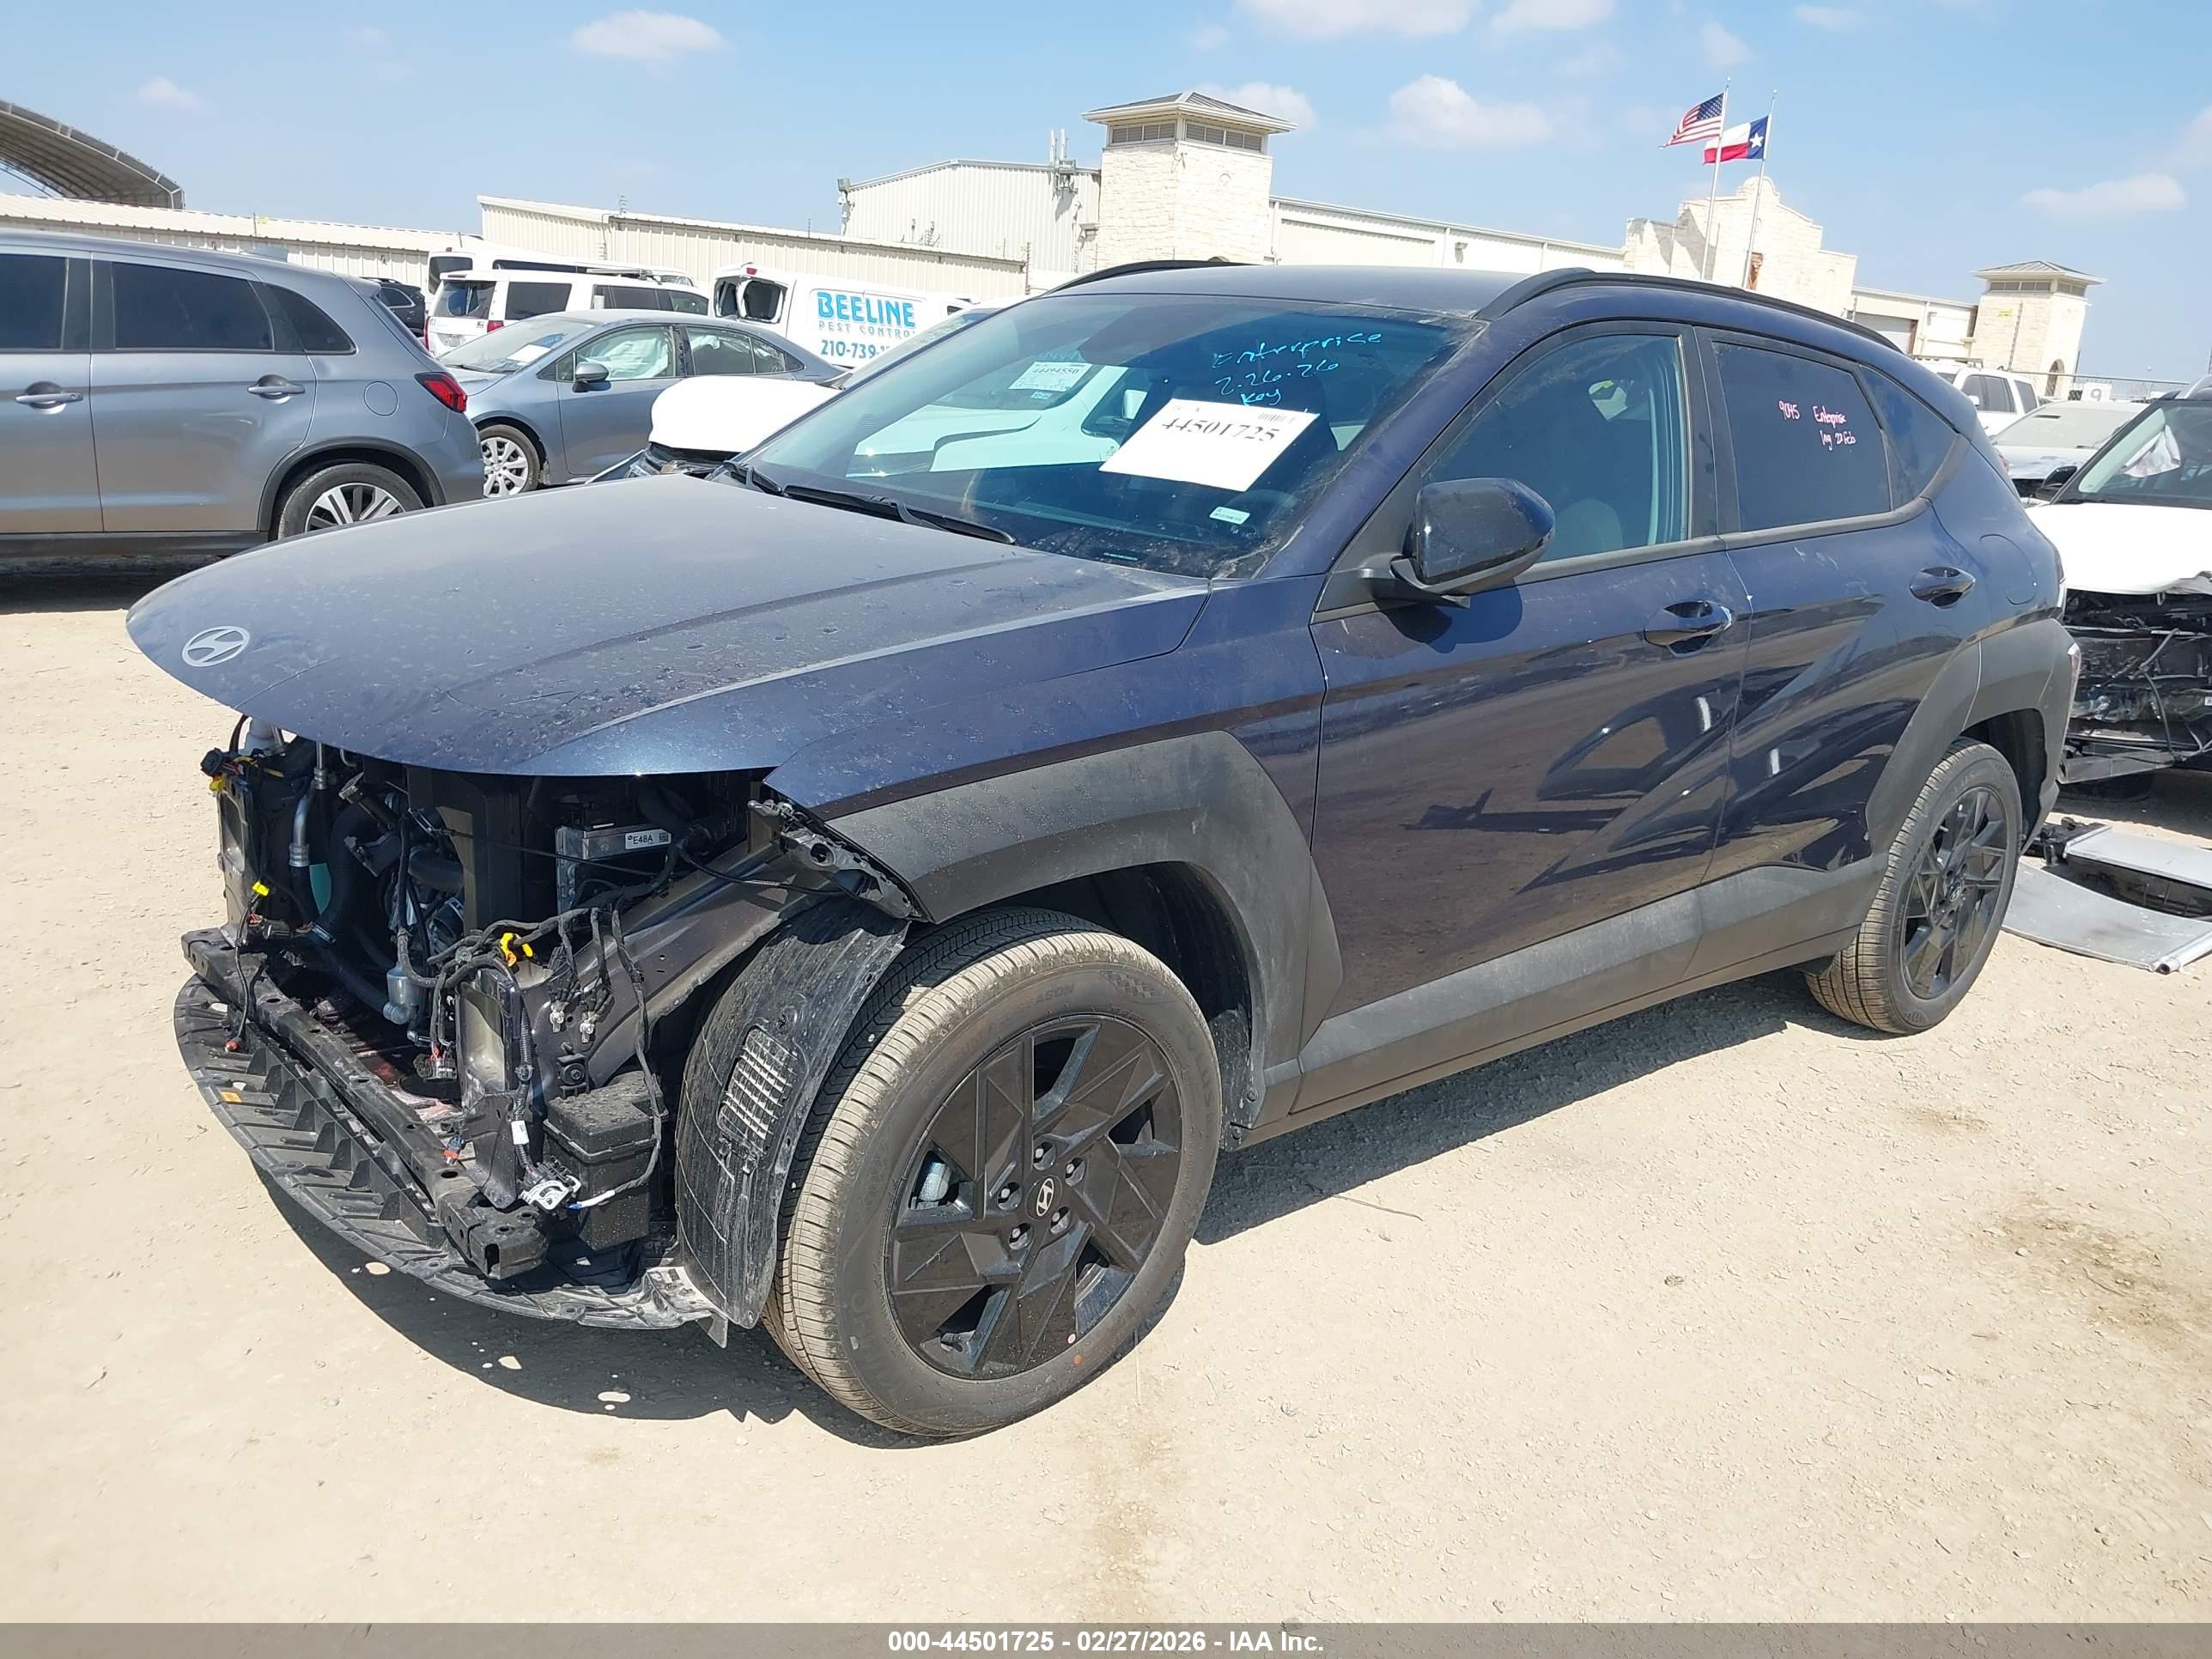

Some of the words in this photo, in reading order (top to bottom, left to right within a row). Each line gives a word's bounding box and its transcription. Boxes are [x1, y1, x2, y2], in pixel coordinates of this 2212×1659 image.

[817, 291, 915, 327] BEELINE
[818, 320, 851, 333] PEST
[860, 326, 916, 340] CONTRO
[1161, 417, 1280, 441] 44501725
